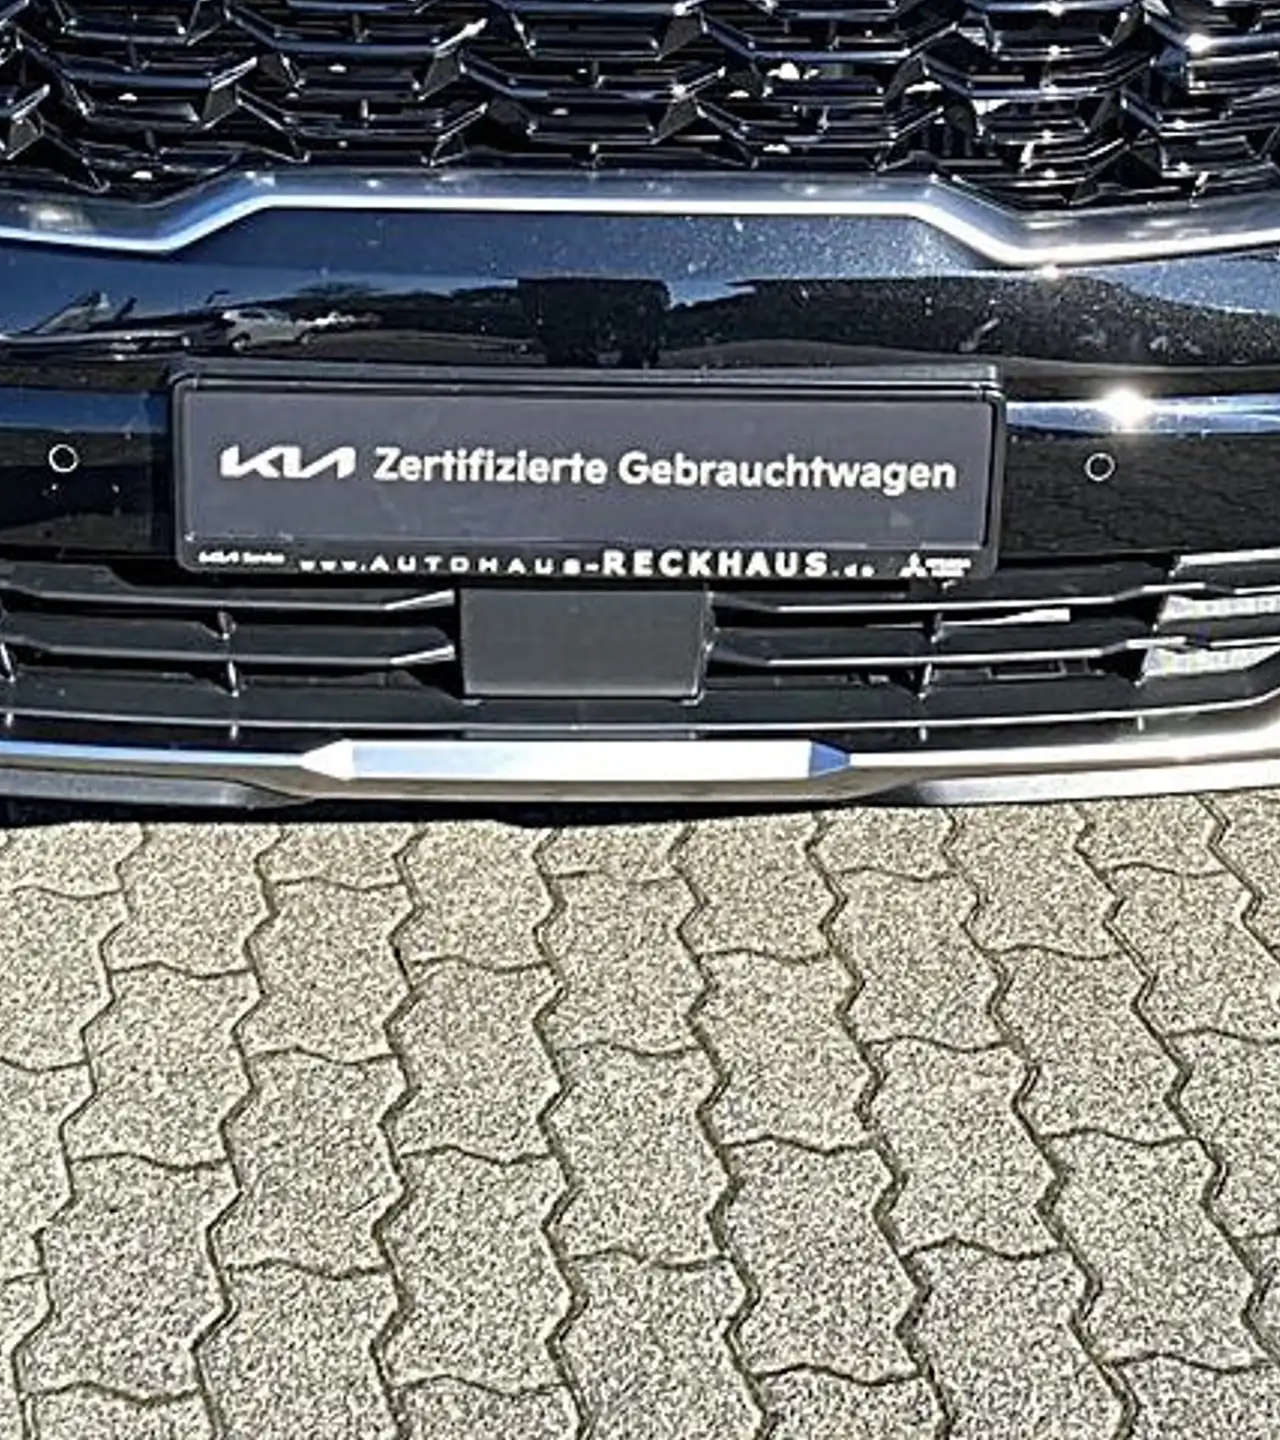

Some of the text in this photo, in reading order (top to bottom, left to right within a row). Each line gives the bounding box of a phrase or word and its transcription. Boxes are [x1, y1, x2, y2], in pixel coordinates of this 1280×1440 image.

[220, 445, 957, 497] KIA Zertifizierte Gebrauchtwagen
